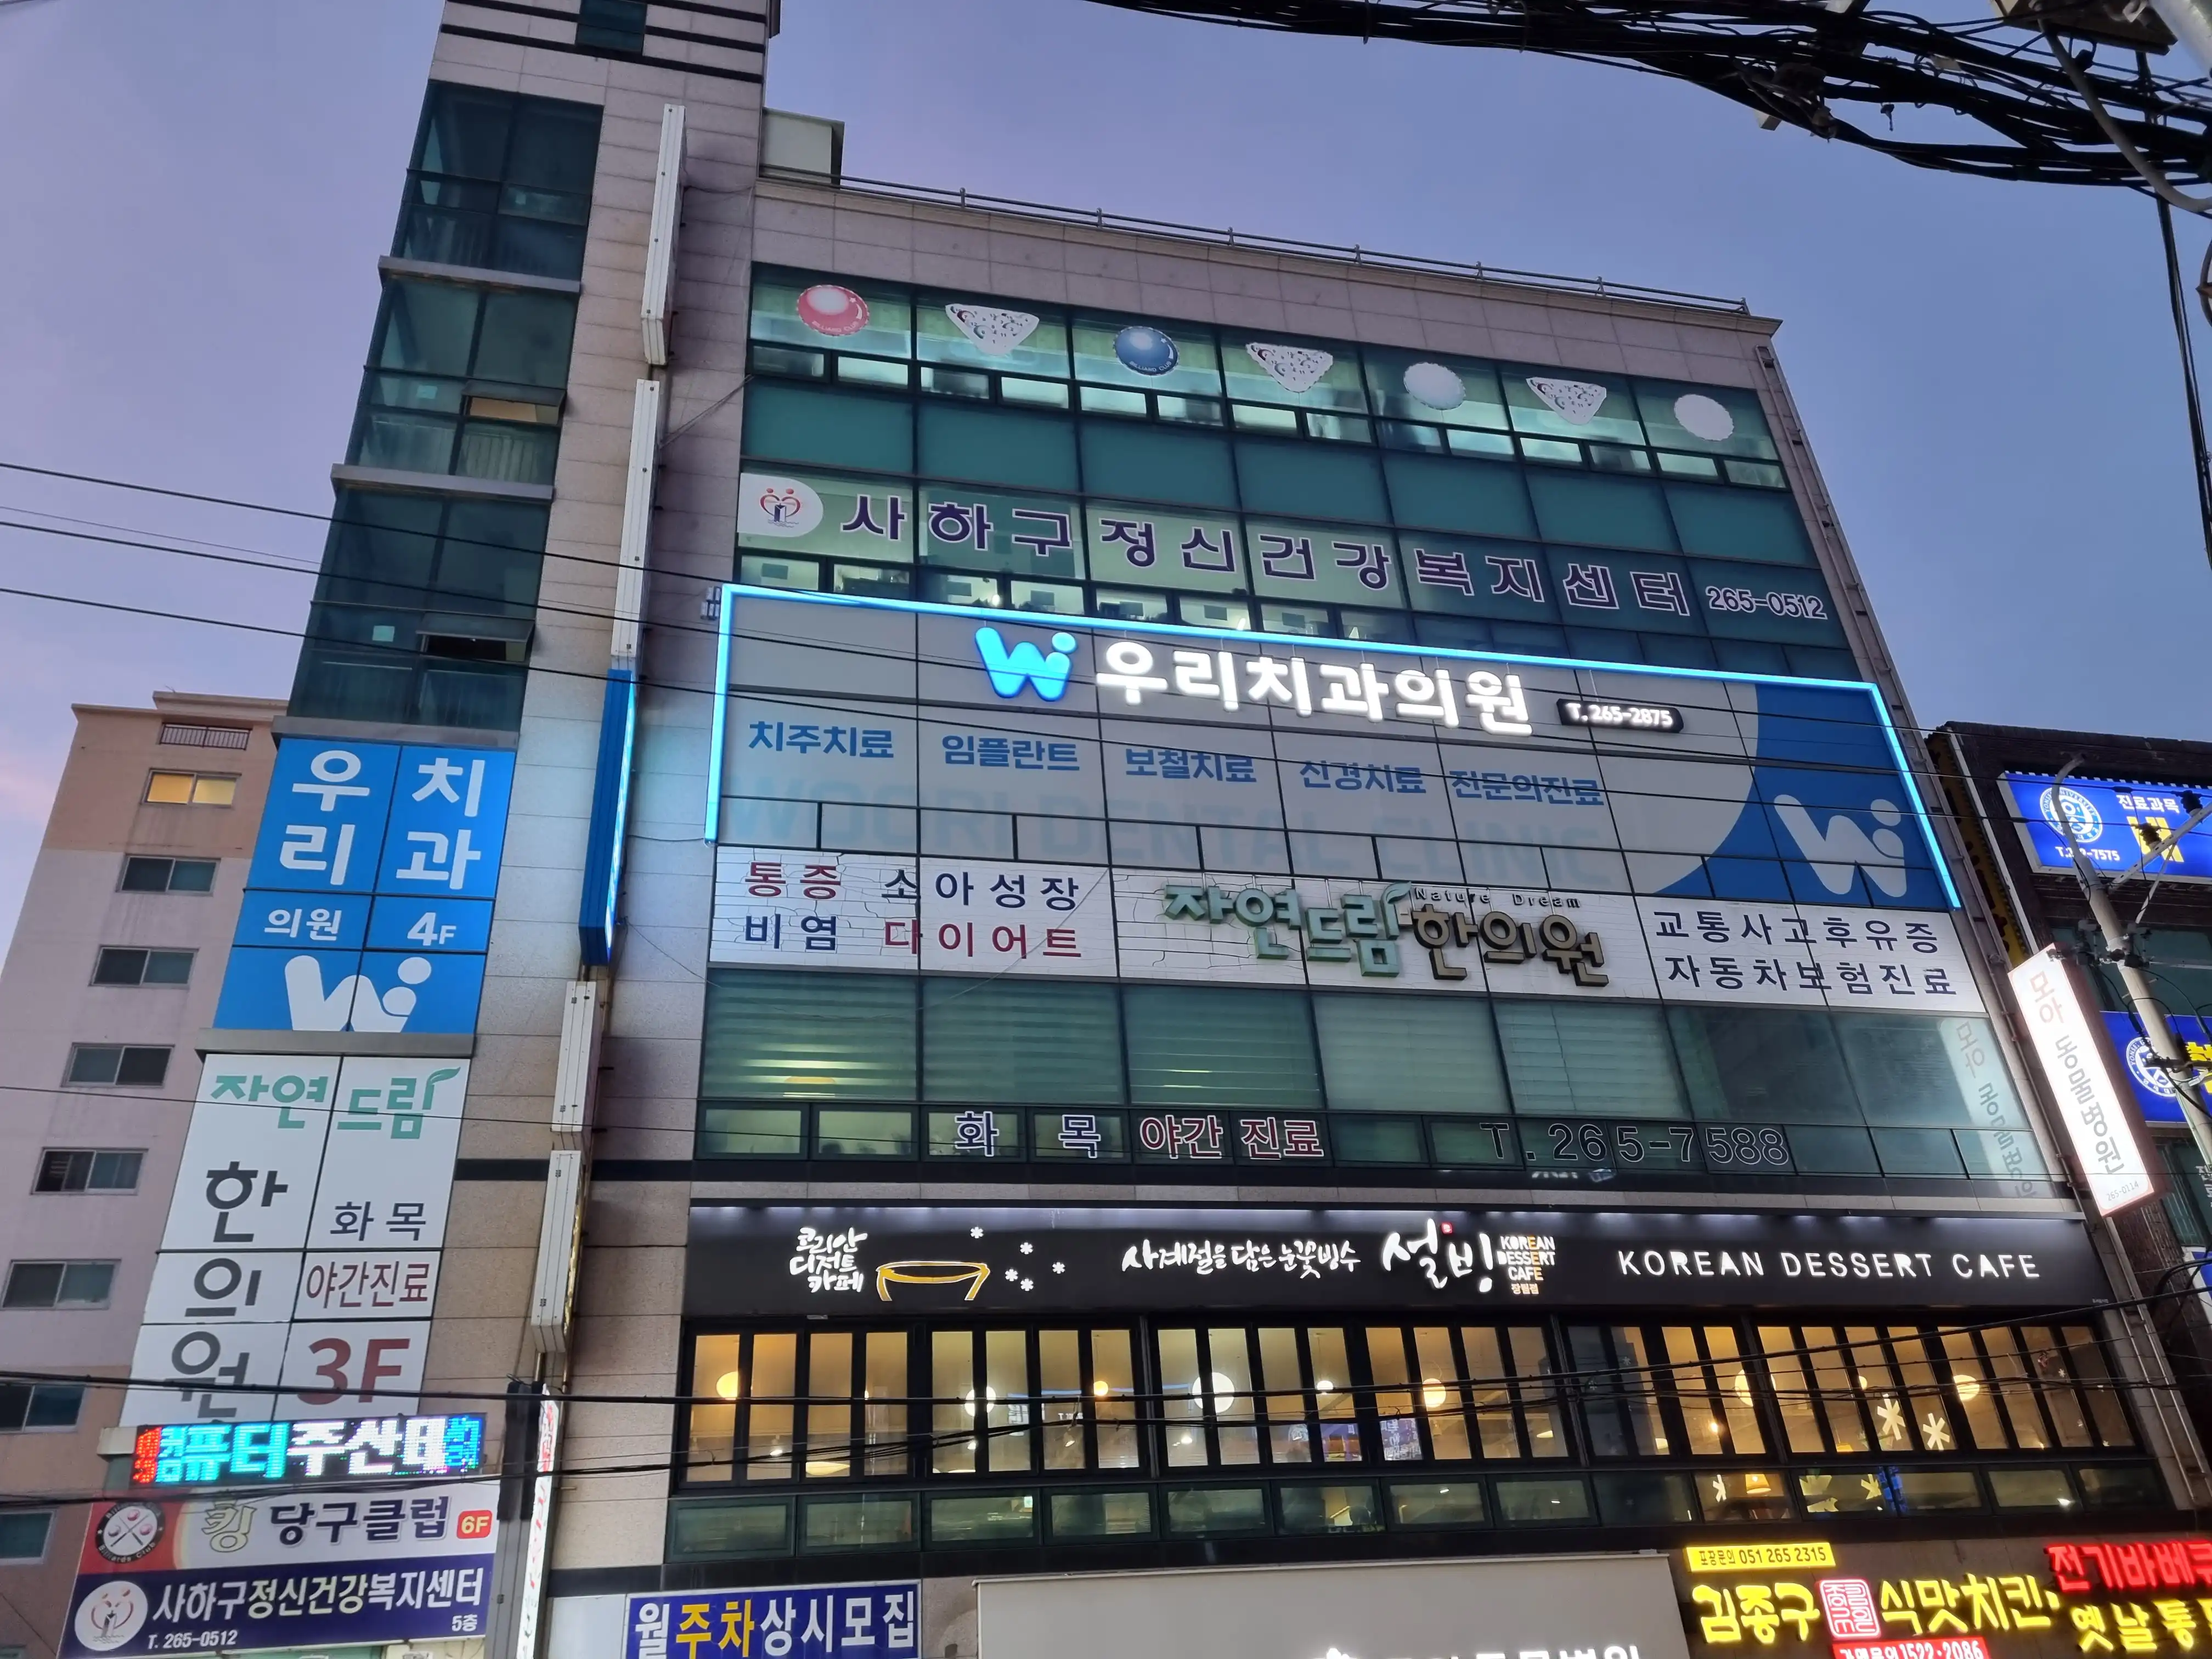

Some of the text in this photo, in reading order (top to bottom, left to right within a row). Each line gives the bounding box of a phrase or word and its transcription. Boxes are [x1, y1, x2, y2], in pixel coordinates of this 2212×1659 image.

[1705, 585, 1828, 622] 265-0512
[1096, 640, 1534, 737] 우리치과의원
[748, 721, 1605, 806] 치주치료 임플란트 보철치료 신경치료 전문의진료
[2116, 794, 2180, 814] 진료과목
[745, 861, 1080, 912] 통증 소아성장
[1415, 887, 1581, 909] Nature Dream
[264, 909, 342, 941] 의원
[407, 912, 456, 946] 4F
[745, 912, 1082, 960] 비염 다이어트
[1164, 881, 1610, 988] 자연드림 한의원
[1653, 910, 1939, 955] 교통사고후유증
[1664, 954, 1957, 996] 자동차보험진료
[210, 1066, 461, 1139] 자연드림
[2055, 1035, 2126, 1175] 동물병원
[953, 1110, 1324, 1160] 화 목 야간 진료
[1548, 1122, 1790, 1166] 265-7588
[2107, 1180, 2140, 1201] 265-0114
[796, 1227, 868, 1254] 코리안
[1121, 1238, 1227, 1275] 사계절을
[1231, 1239, 1277, 1272] 담은
[1496, 1251, 1556, 1266] DESSERT
[1500, 1235, 1556, 1250] KOREAN
[789, 1251, 857, 1276] 디저트
[808, 1269, 864, 1293] 카페
[1508, 1266, 1544, 1280] CAFE
[1617, 1250, 2041, 1279] KOREAN DESSERT CAFE
[165, 1161, 289, 1419] 한의원
[305, 1260, 430, 1309] 야간진료
[296, 1338, 410, 1406] 3F
[270, 1497, 451, 1546] 당구클럽
[461, 1515, 489, 1534] 6F
[1739, 1548, 1763, 1565] 051
[1767, 1547, 1791, 1564] 265
[1794, 1546, 1826, 1562] 2315
[153, 1567, 484, 1623] 사하구정신건강복지센터
[1692, 1583, 1821, 1644] 김종구
[163, 1630, 237, 1649] 265-0512
[451, 1613, 478, 1632] 5층
